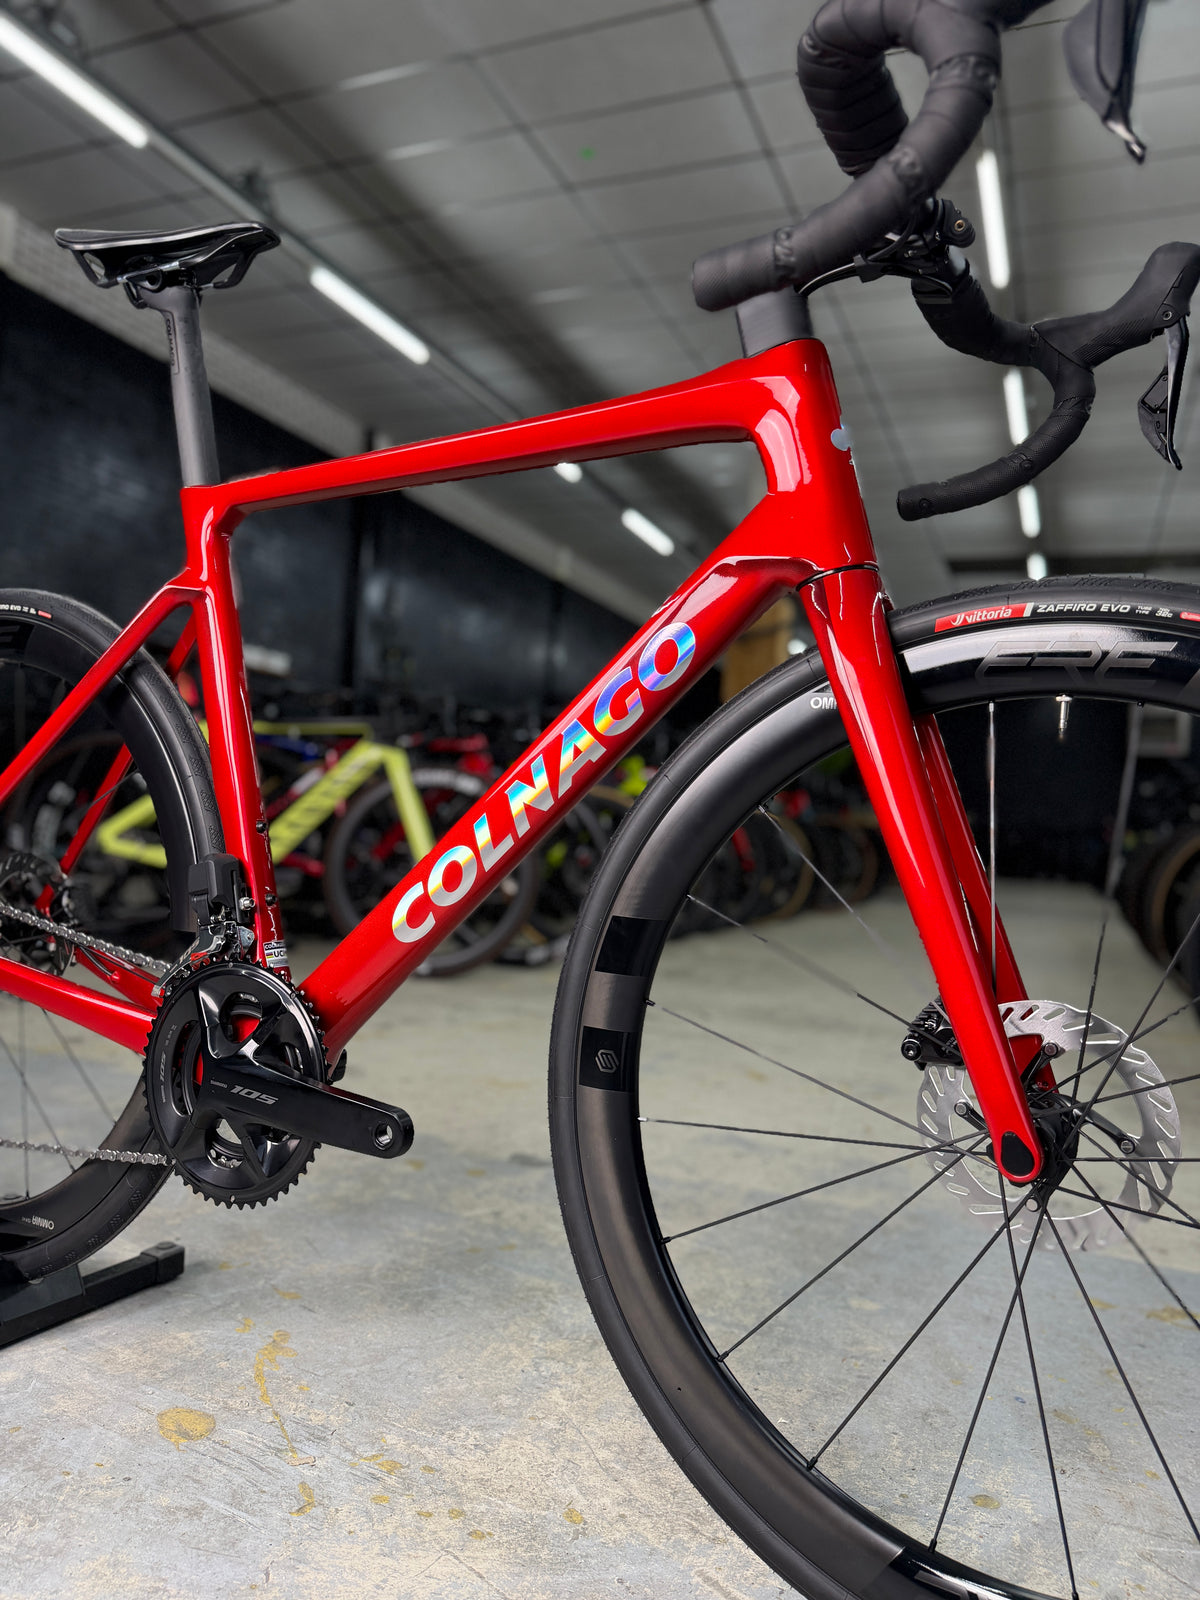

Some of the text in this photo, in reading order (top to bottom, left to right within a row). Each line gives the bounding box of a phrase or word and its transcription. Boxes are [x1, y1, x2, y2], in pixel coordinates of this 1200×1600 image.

[1036, 603, 1097, 613] ZAFFIRO
[1099, 603, 1131, 613] EVO
[392, 622, 696, 943] COLNAGO
[230, 1084, 279, 1105] 105
